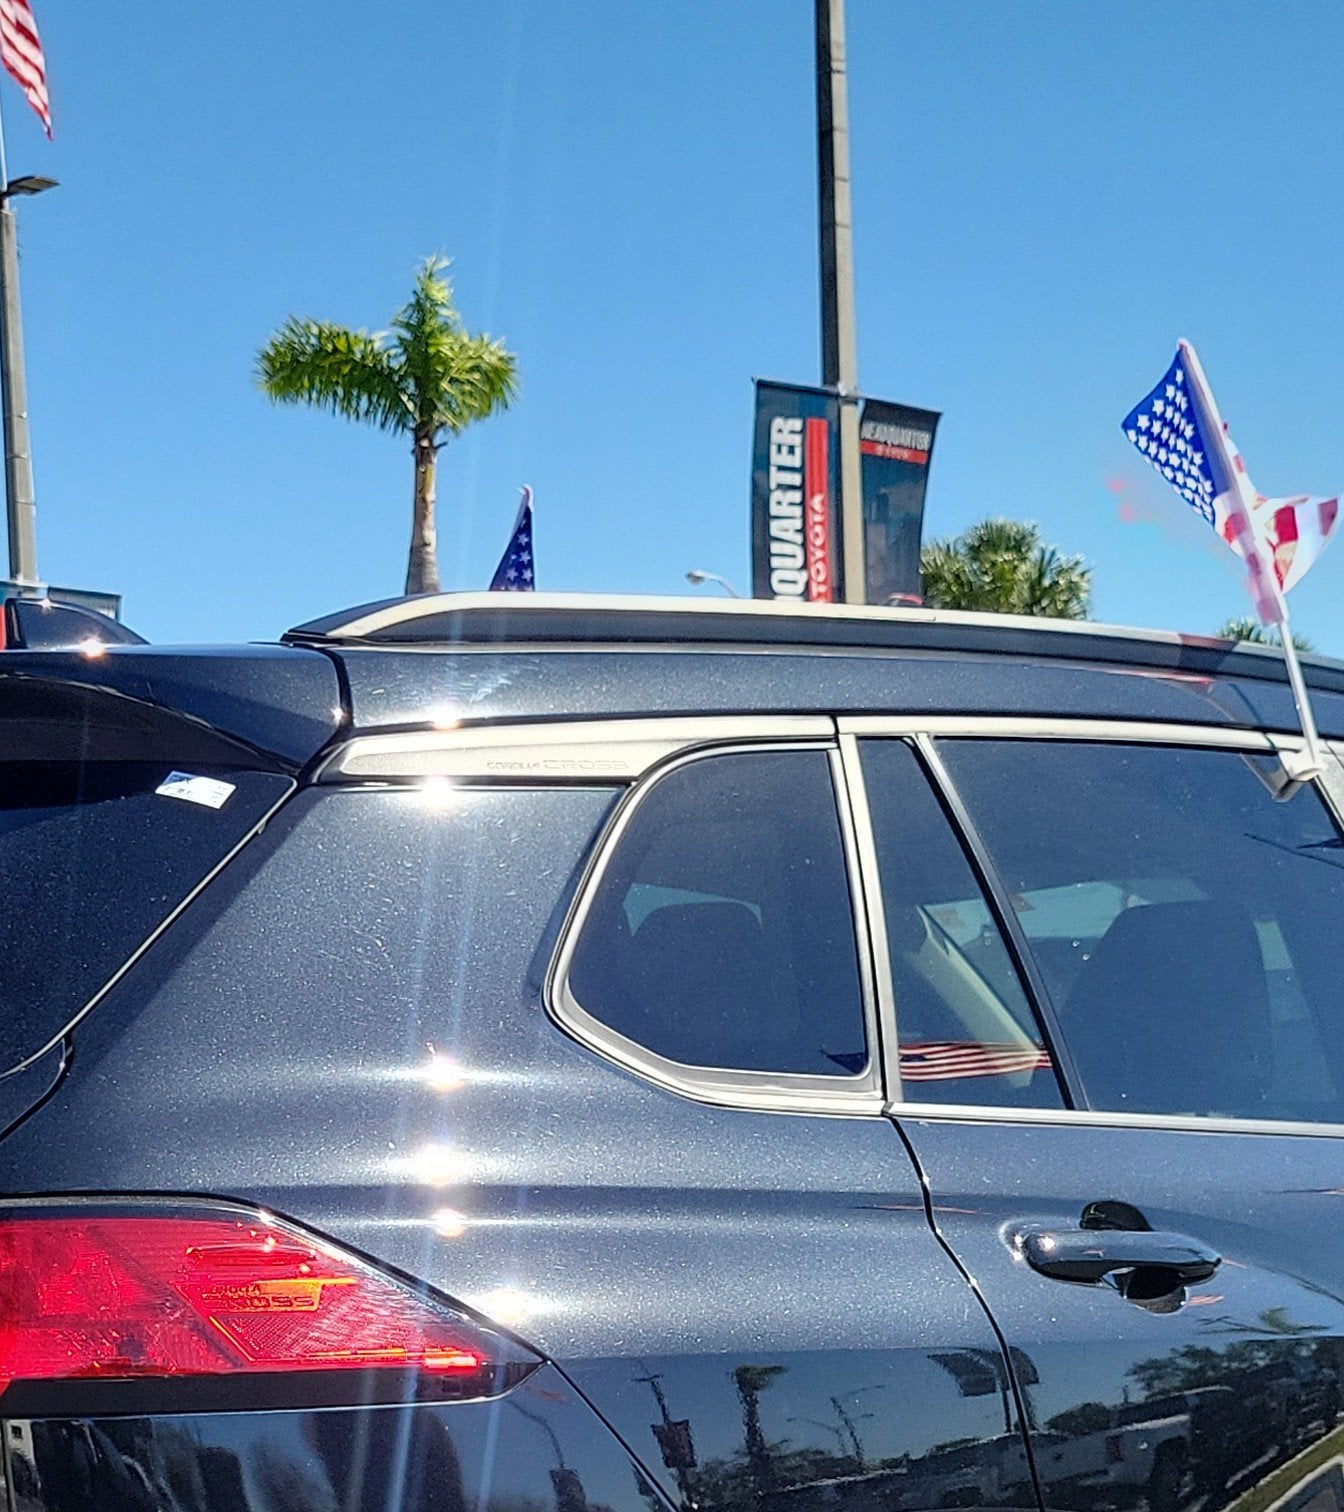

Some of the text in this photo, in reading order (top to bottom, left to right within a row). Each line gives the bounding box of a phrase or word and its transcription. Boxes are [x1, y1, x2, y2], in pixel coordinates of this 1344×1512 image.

[768, 416, 808, 601] QUARTER
[809, 492, 829, 598] TOYOTA
[542, 759, 629, 770] CROSS
